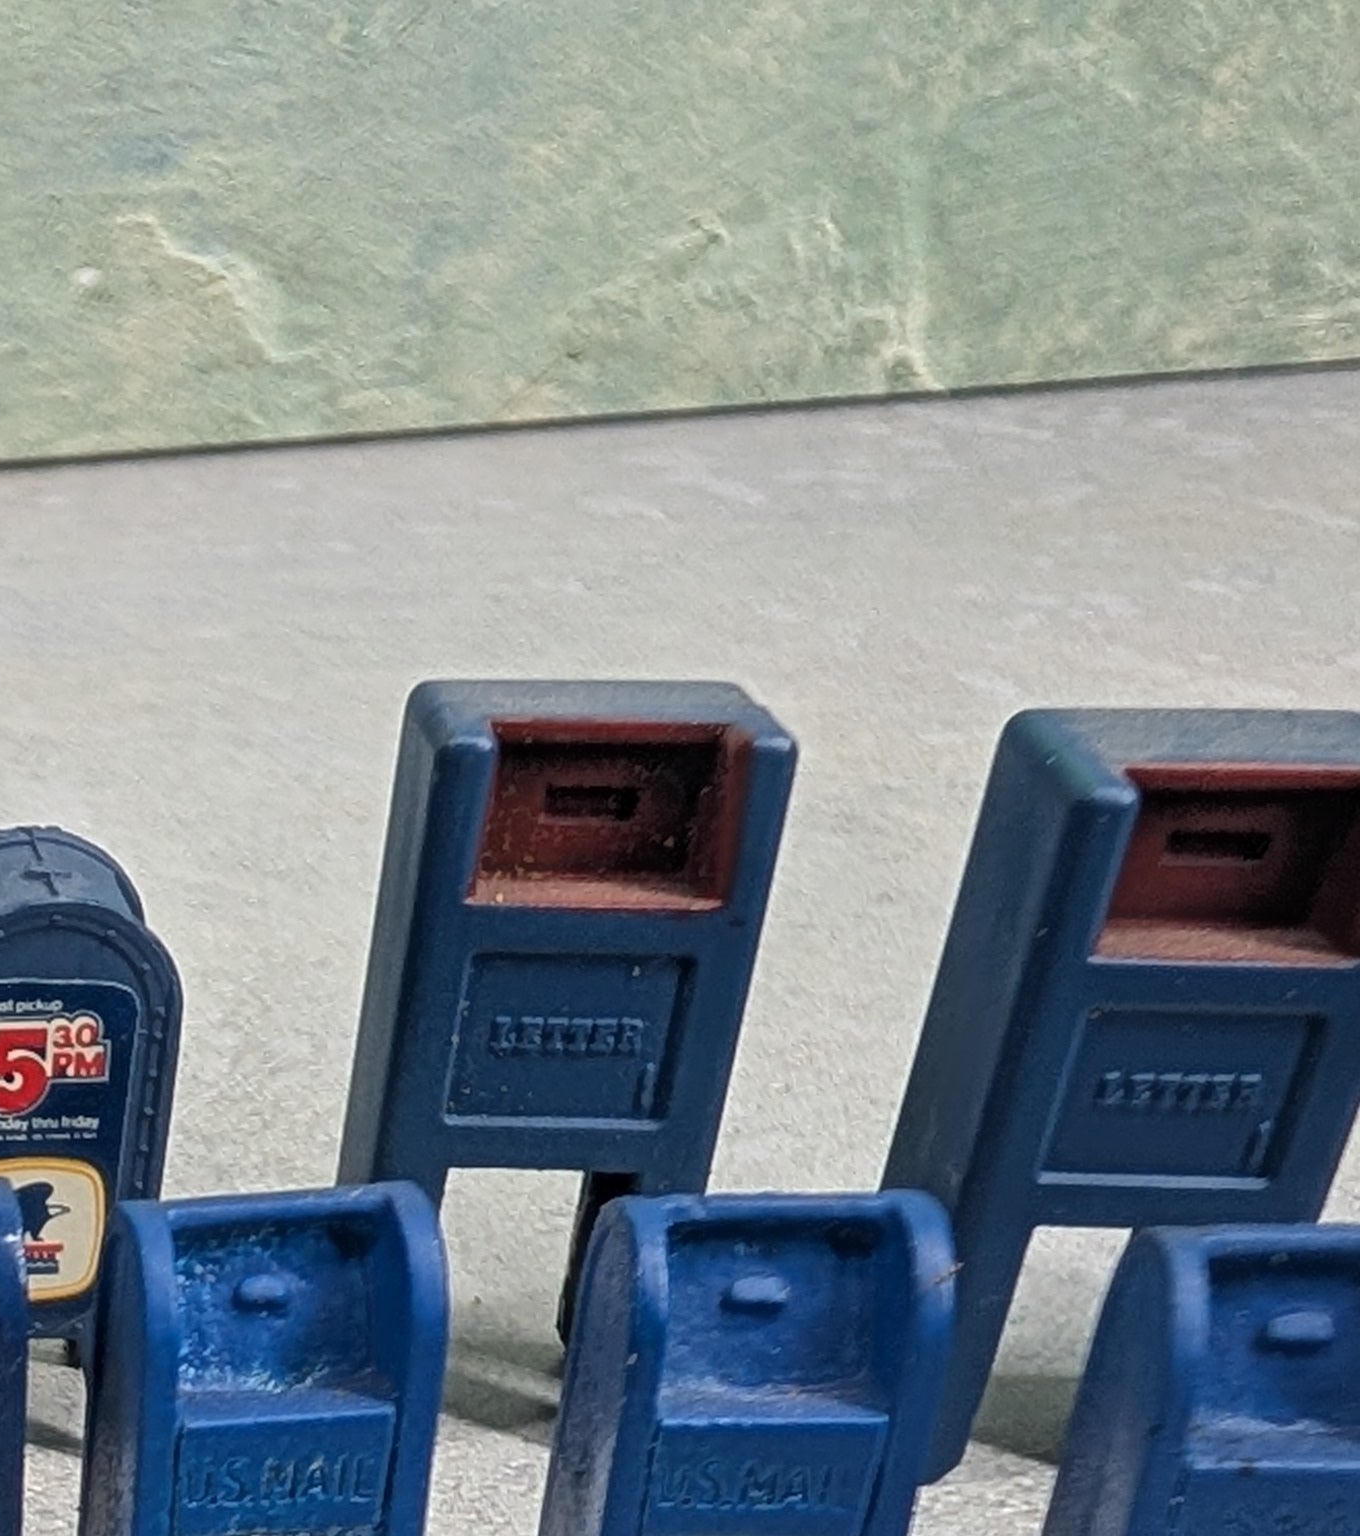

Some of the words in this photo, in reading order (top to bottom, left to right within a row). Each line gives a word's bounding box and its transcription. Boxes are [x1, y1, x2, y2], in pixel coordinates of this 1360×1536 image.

[15, 999, 63, 1014] pickup
[51, 1020, 101, 1049] 30
[490, 1015, 644, 1057] LETTER
[51, 1051, 107, 1078] PM
[1094, 1071, 1262, 1111] LETTER
